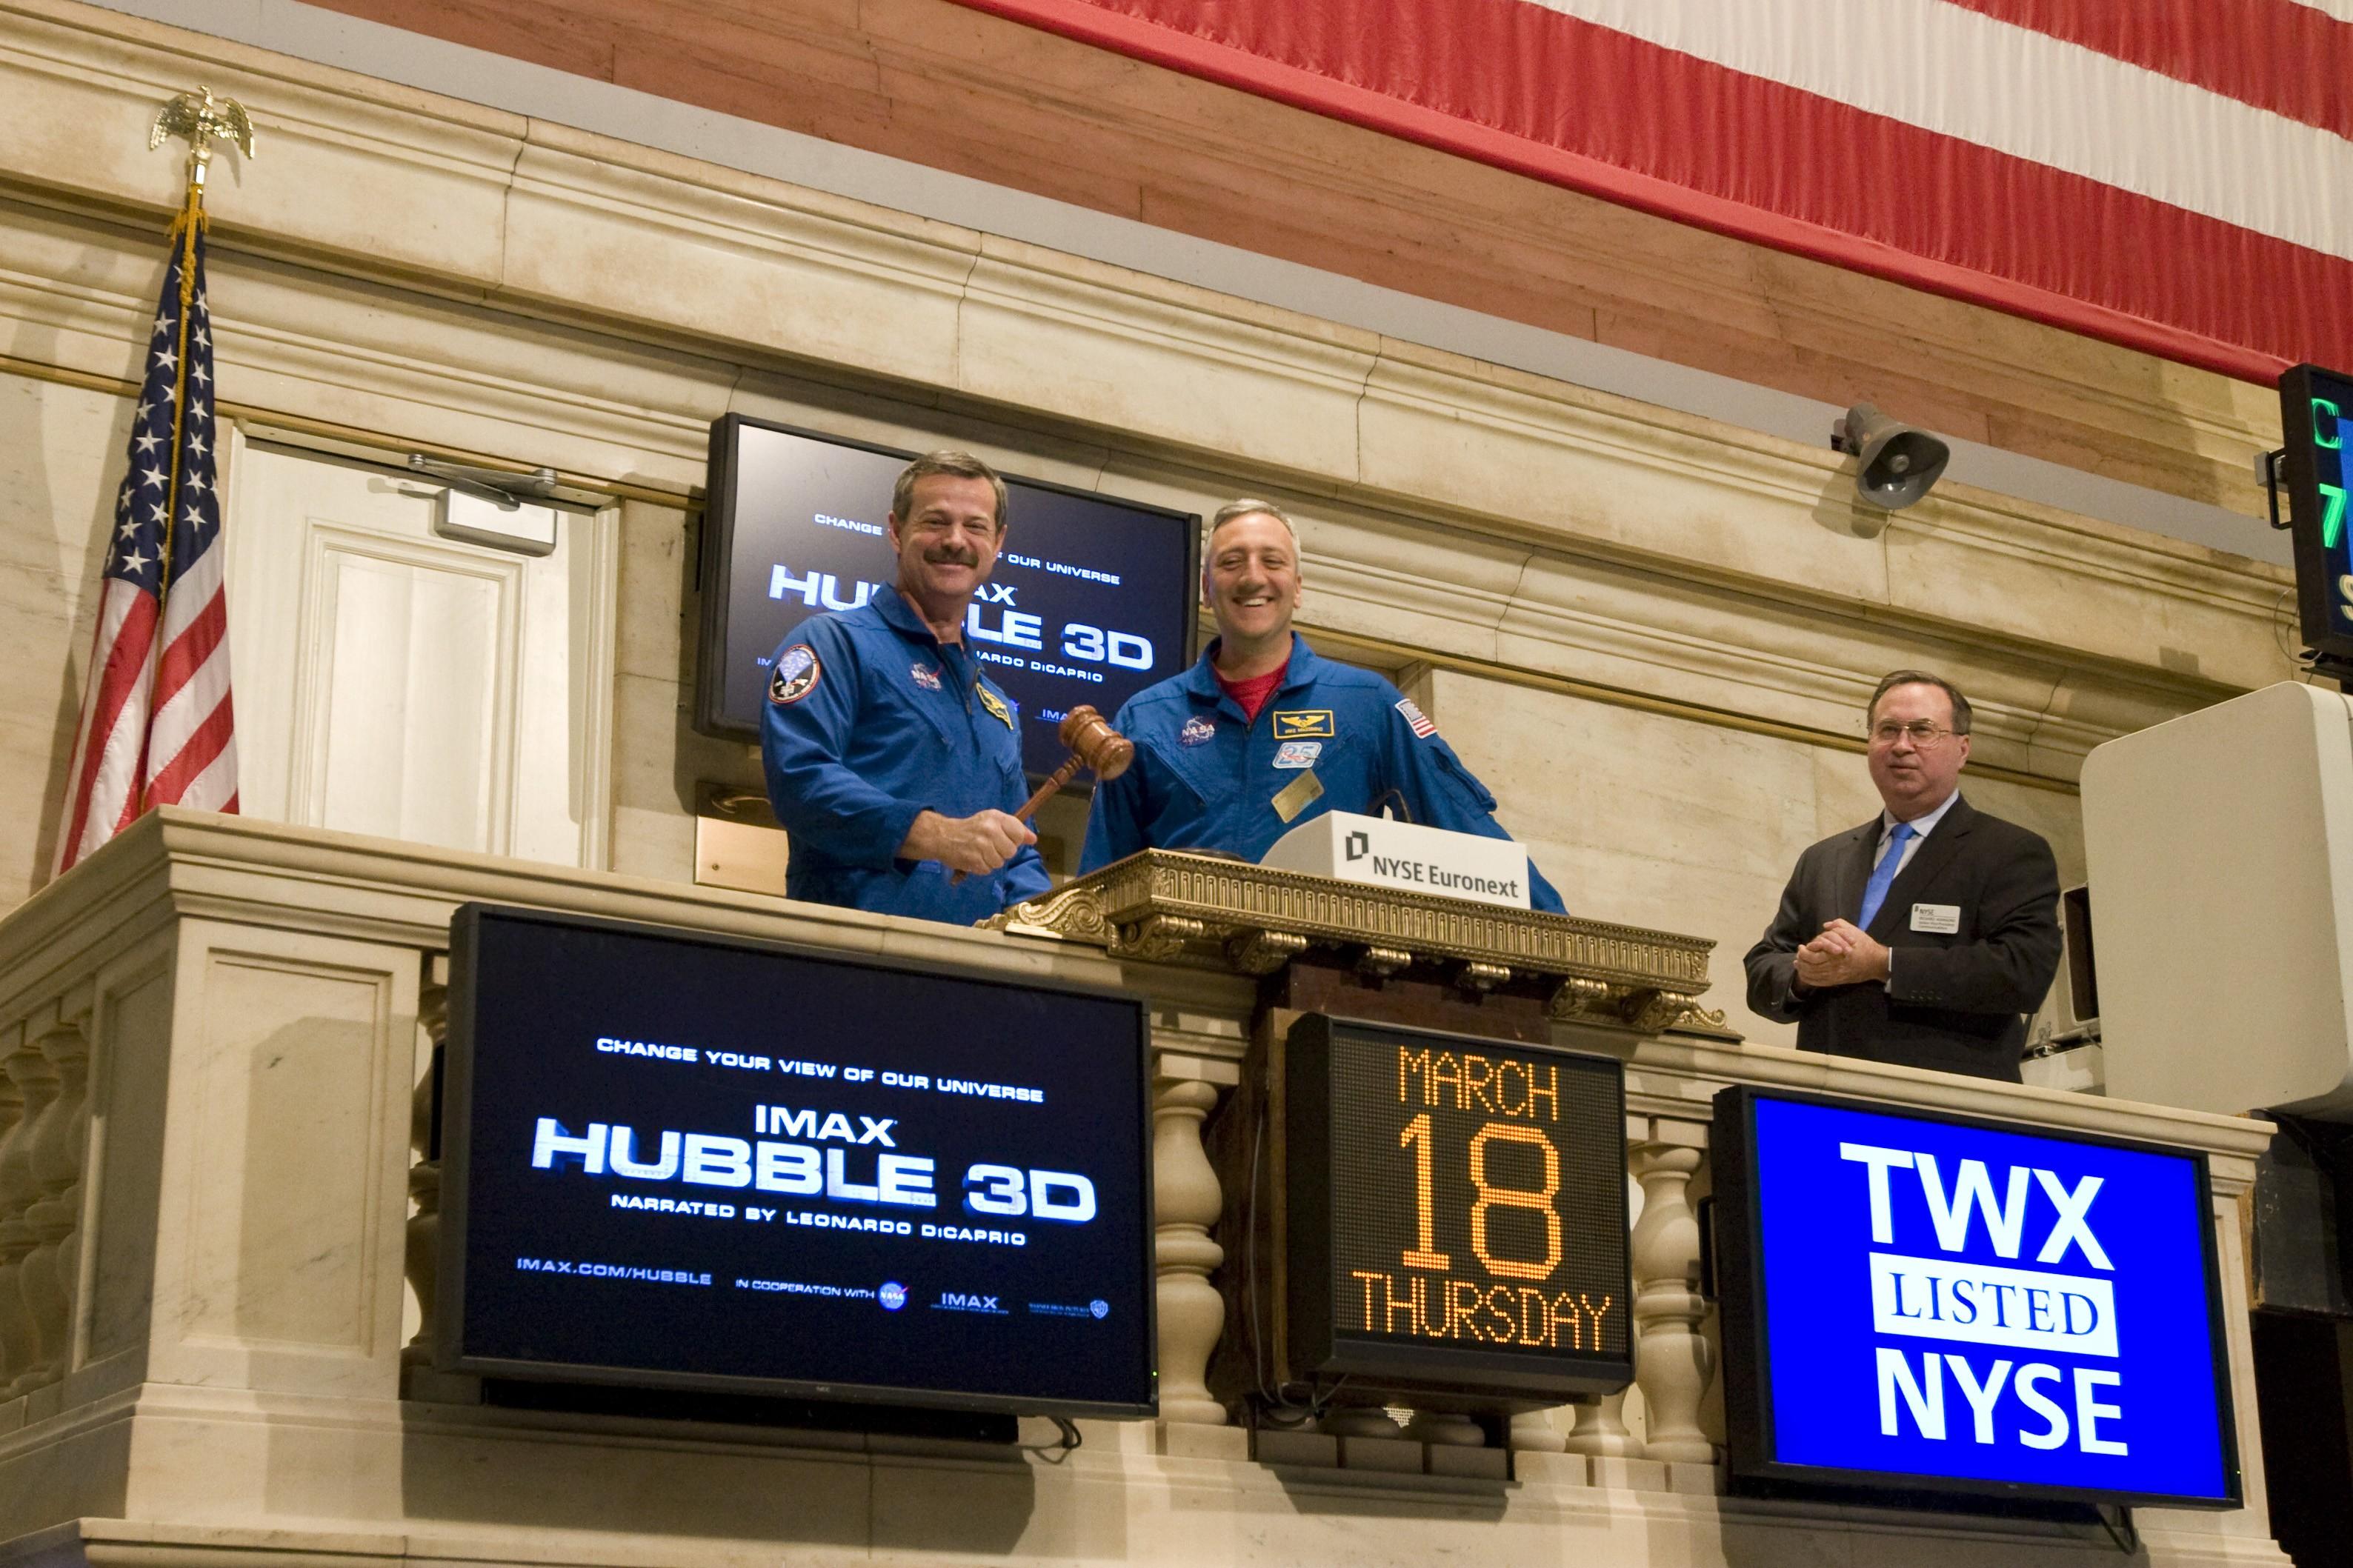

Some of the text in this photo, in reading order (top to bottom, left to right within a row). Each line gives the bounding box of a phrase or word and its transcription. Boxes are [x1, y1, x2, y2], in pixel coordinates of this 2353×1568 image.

[815, 514, 1119, 584] CHANGE OUR UNIVERSE
[974, 583, 1016, 607] AX
[976, 650, 1024, 667] ARDO
[1063, 623, 1154, 670] 3D
[1042, 708, 1069, 722] IMA
[1182, 724, 1215, 738] NASA
[1373, 855, 1519, 898] NYSE Euronext
[597, 1038, 1043, 1102] CHANGE YOUR VIEW OF OUR UNIVERSE
[1400, 1046, 1557, 1121] MARCH
[754, 1104, 893, 1147] IMAX
[532, 1117, 1096, 1221] HUBBLE 3D
[611, 1195, 734, 1217] NARRATED
[746, 1207, 776, 1221] BY
[787, 1212, 911, 1234] LEONARDO
[1401, 1113, 1562, 1280] 18
[1840, 1142, 2115, 1271] TWX
[518, 1258, 710, 1284] IMAX.COM/HUBBLE
[736, 1279, 874, 1298] IN COOPERATION WITH
[881, 1291, 904, 1301] NASA
[941, 1292, 999, 1310] IMAX
[1353, 1271, 1611, 1351] THURSDAY
[1889, 1272, 2099, 1336] LISTED
[1876, 1347, 2129, 1457] NYSE
